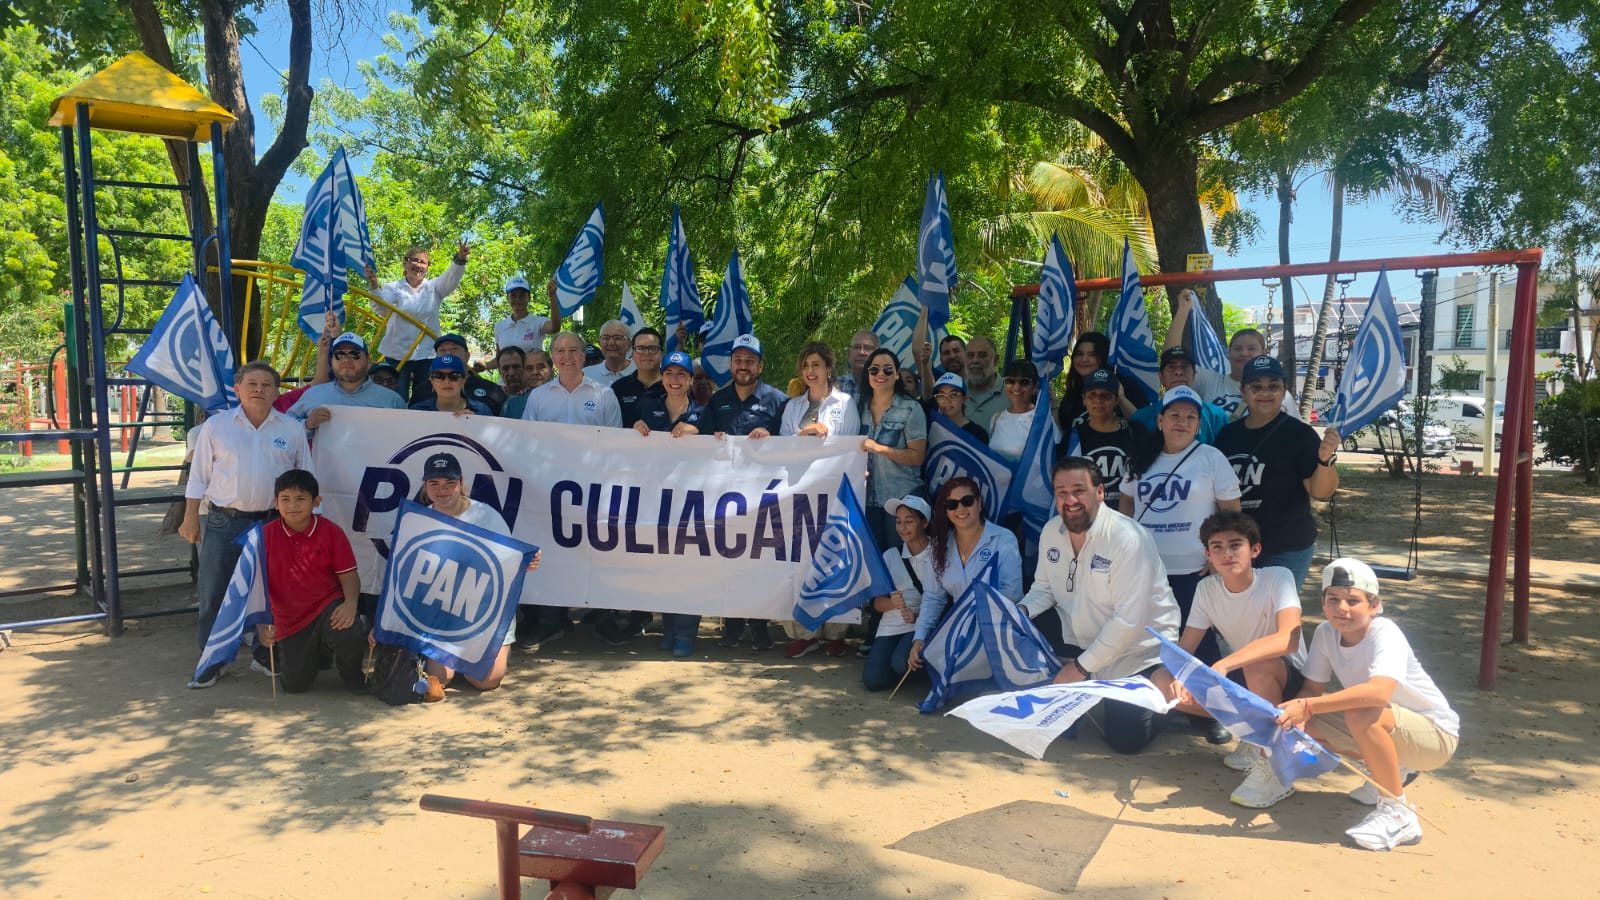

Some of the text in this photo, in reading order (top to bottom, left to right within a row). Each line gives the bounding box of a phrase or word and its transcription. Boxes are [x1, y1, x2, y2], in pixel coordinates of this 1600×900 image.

[566, 231, 599, 288] PAN
[1121, 285, 1155, 351] PA
[352, 466, 828, 563] PN CULIACÁN
[1137, 479, 1192, 502] PAN
[402, 548, 492, 624] PAN
